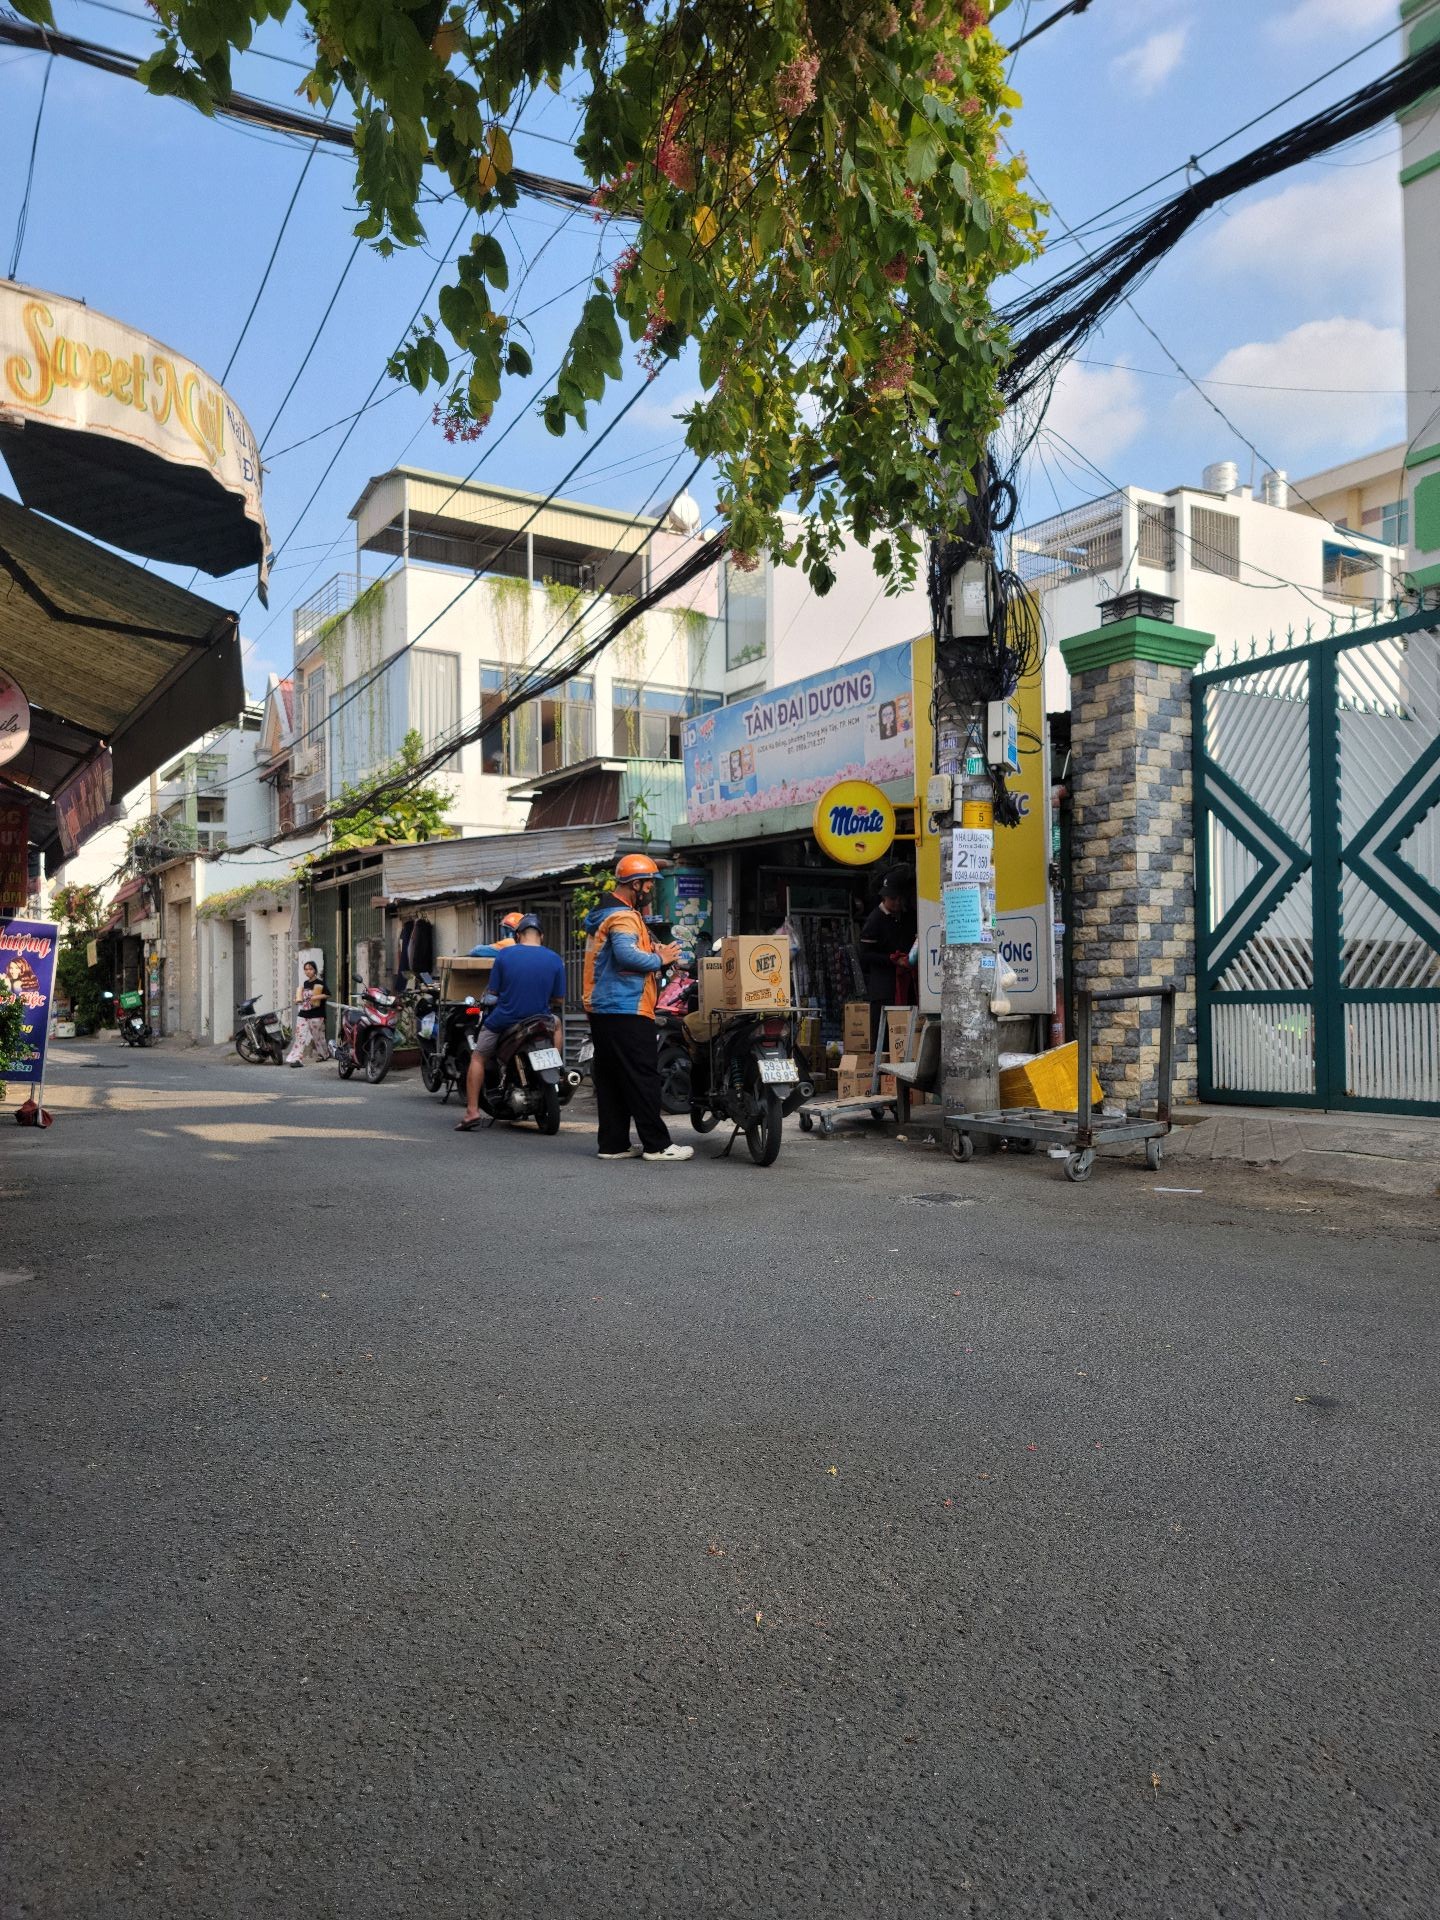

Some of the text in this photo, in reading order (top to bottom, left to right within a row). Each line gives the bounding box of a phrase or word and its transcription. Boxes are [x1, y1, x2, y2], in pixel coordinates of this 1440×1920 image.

[5, 301, 149, 412] Sweet
[745, 705, 773, 736] TÂN
[777, 697, 804, 727] ĐẠI
[808, 674, 871, 716] DƯƠNG
[829, 805, 883, 836] Monte
[979, 812, 984, 822] 5
[957, 850, 969, 868] 2
[756, 954, 776, 972] NET
